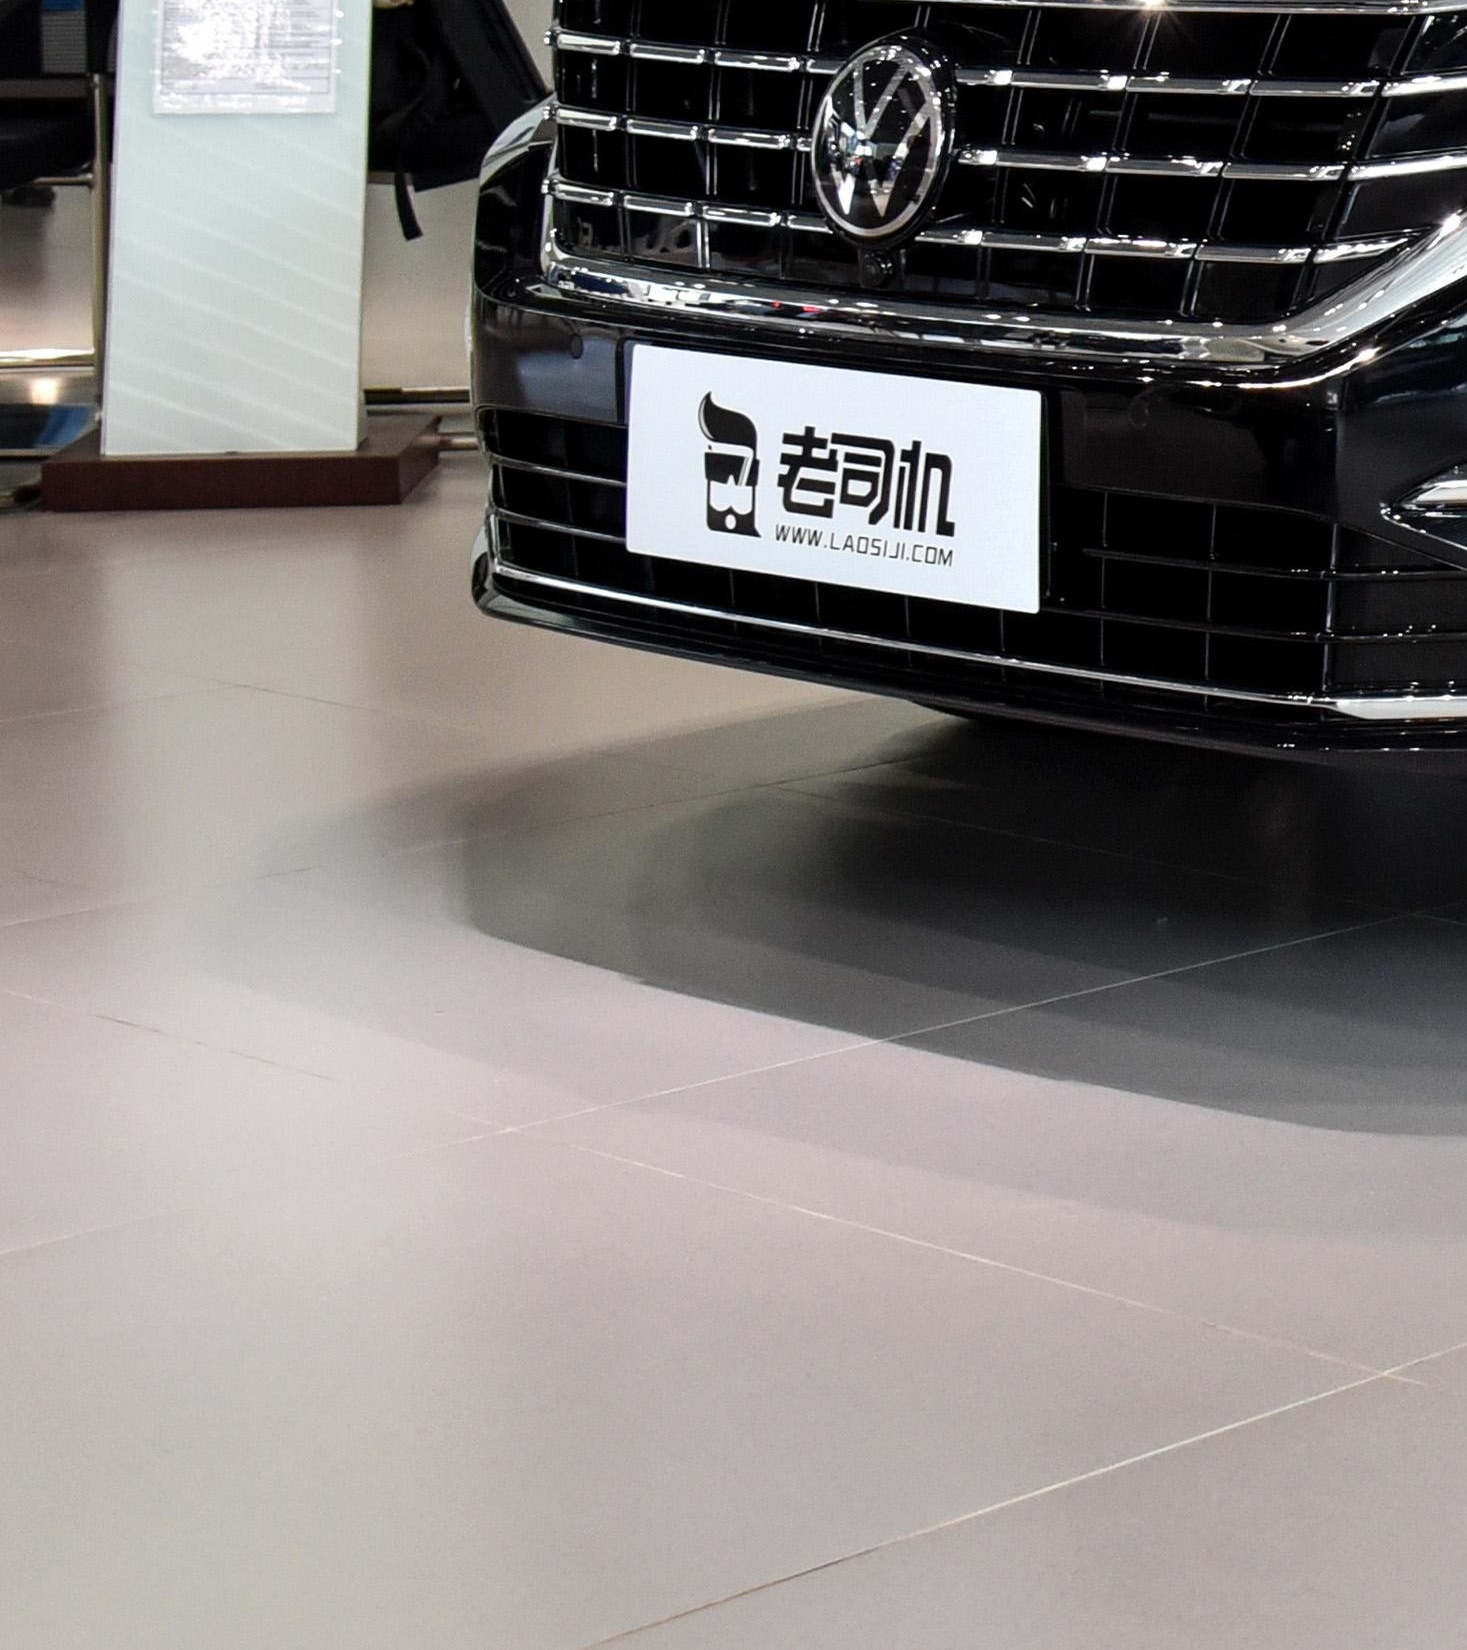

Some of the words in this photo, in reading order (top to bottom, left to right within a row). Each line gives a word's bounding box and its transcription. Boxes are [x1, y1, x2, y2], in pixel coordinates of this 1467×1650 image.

[776, 425, 957, 538] 老司机
[774, 523, 956, 568] WWW.LAOSIJI.COM
